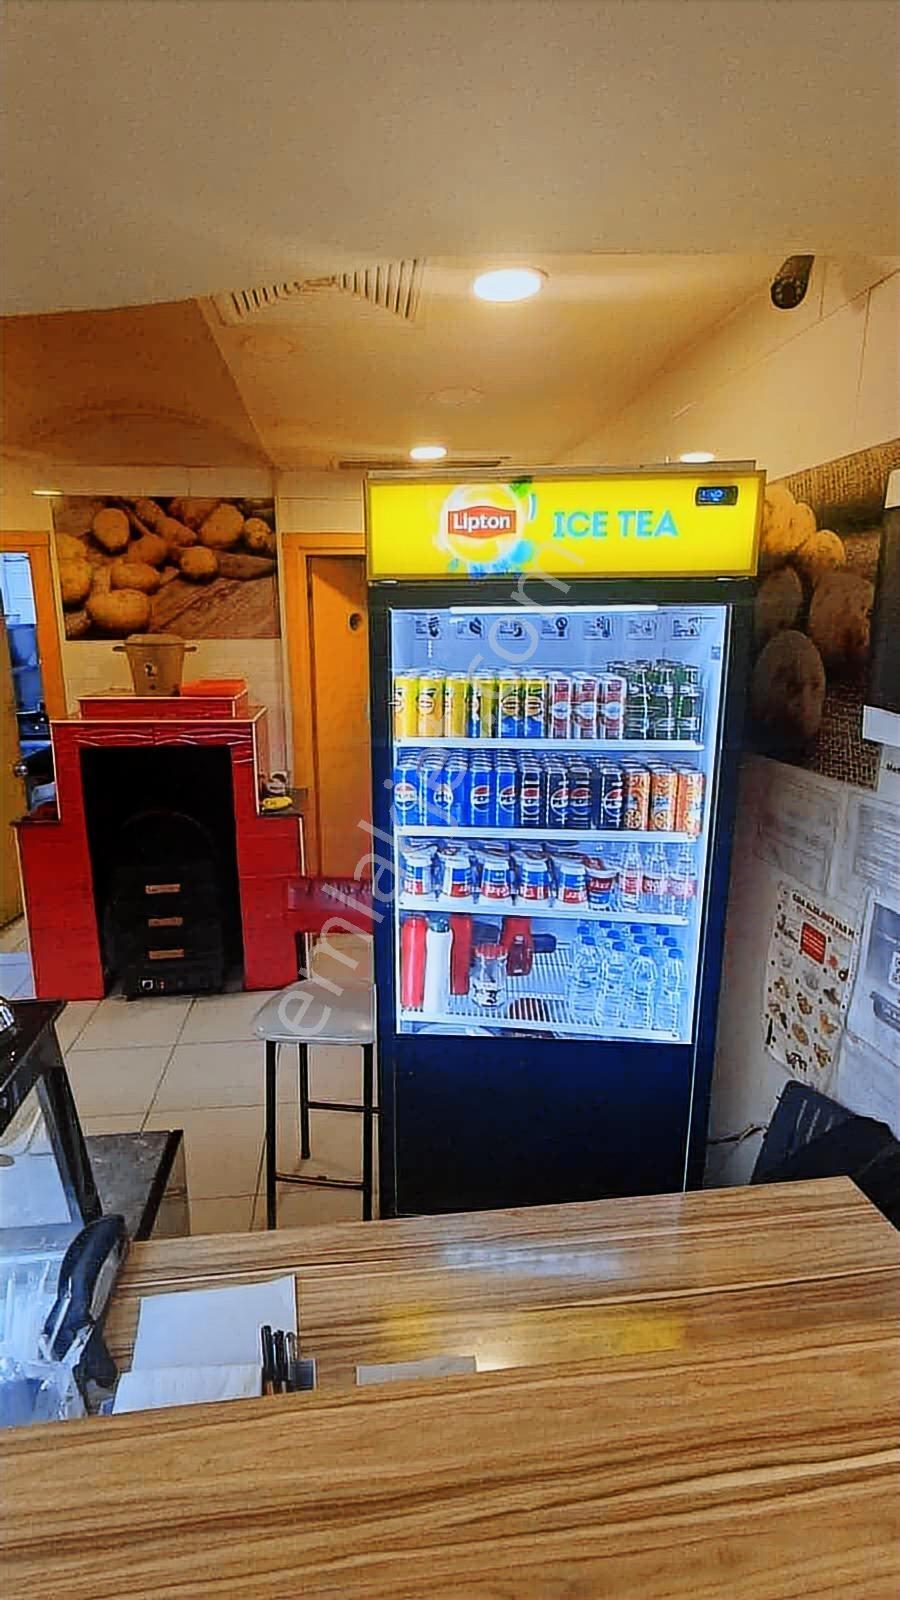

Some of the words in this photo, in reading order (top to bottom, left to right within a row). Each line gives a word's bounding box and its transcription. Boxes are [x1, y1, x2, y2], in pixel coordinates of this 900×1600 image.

[452, 513, 511, 533] Lipton
[553, 511, 608, 538] ICE
[618, 510, 679, 537] TEA
